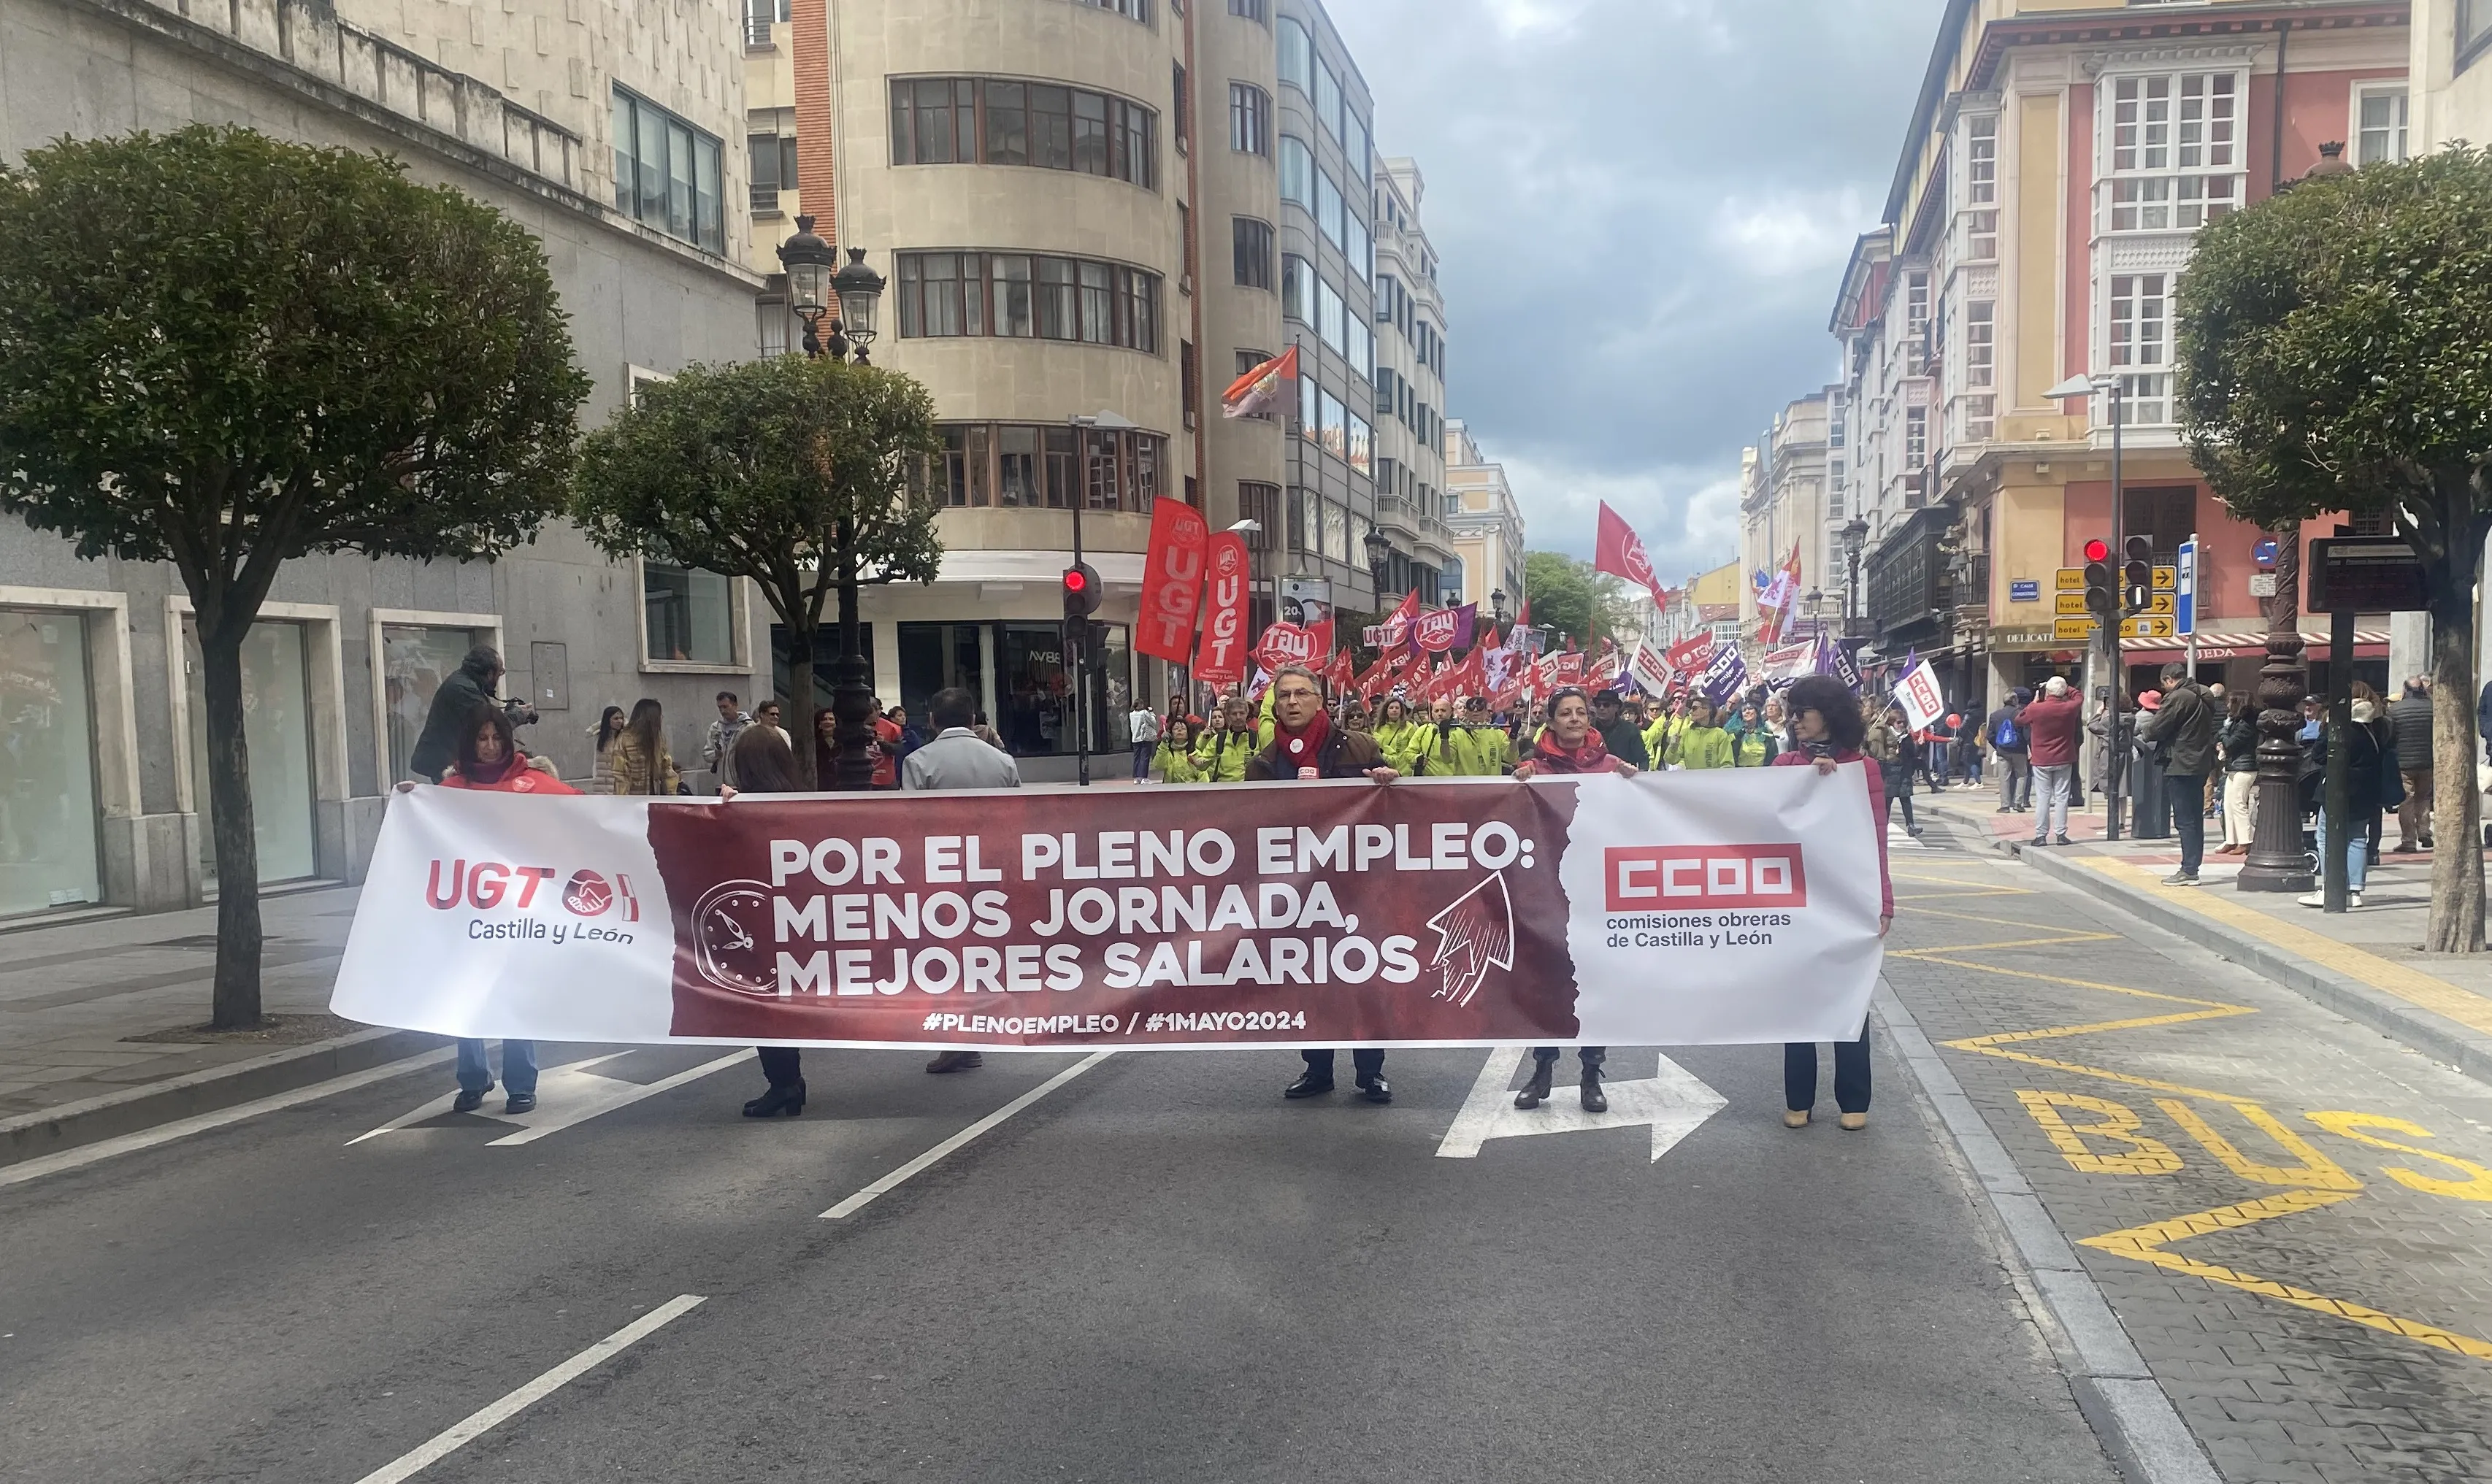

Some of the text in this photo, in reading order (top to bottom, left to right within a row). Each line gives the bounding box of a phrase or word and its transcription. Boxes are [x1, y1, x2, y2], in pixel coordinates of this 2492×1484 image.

[1156, 545, 1198, 647] UGT
[1211, 574, 1238, 666] UGT
[2058, 625, 2080, 634] hotel
[1638, 648, 1665, 680] CCOO
[1911, 674, 1938, 713] CCOO
[770, 820, 1535, 887] POR EL PLENO EMPLEO:
[425, 859, 555, 910] UGT
[1618, 856, 1793, 898] CCOO
[469, 918, 634, 945] Castilla y León
[774, 880, 1360, 943] MENOS JORNADA,
[1606, 911, 1791, 930] comisiones obreras
[1606, 929, 1772, 949] de Castilla y León
[775, 934, 1419, 998] MEJORES SALARIOS
[922, 1010, 1307, 1035] #PLENOEMPLEO / #1MAYO2024
[2013, 1090, 2492, 1202] BUS
